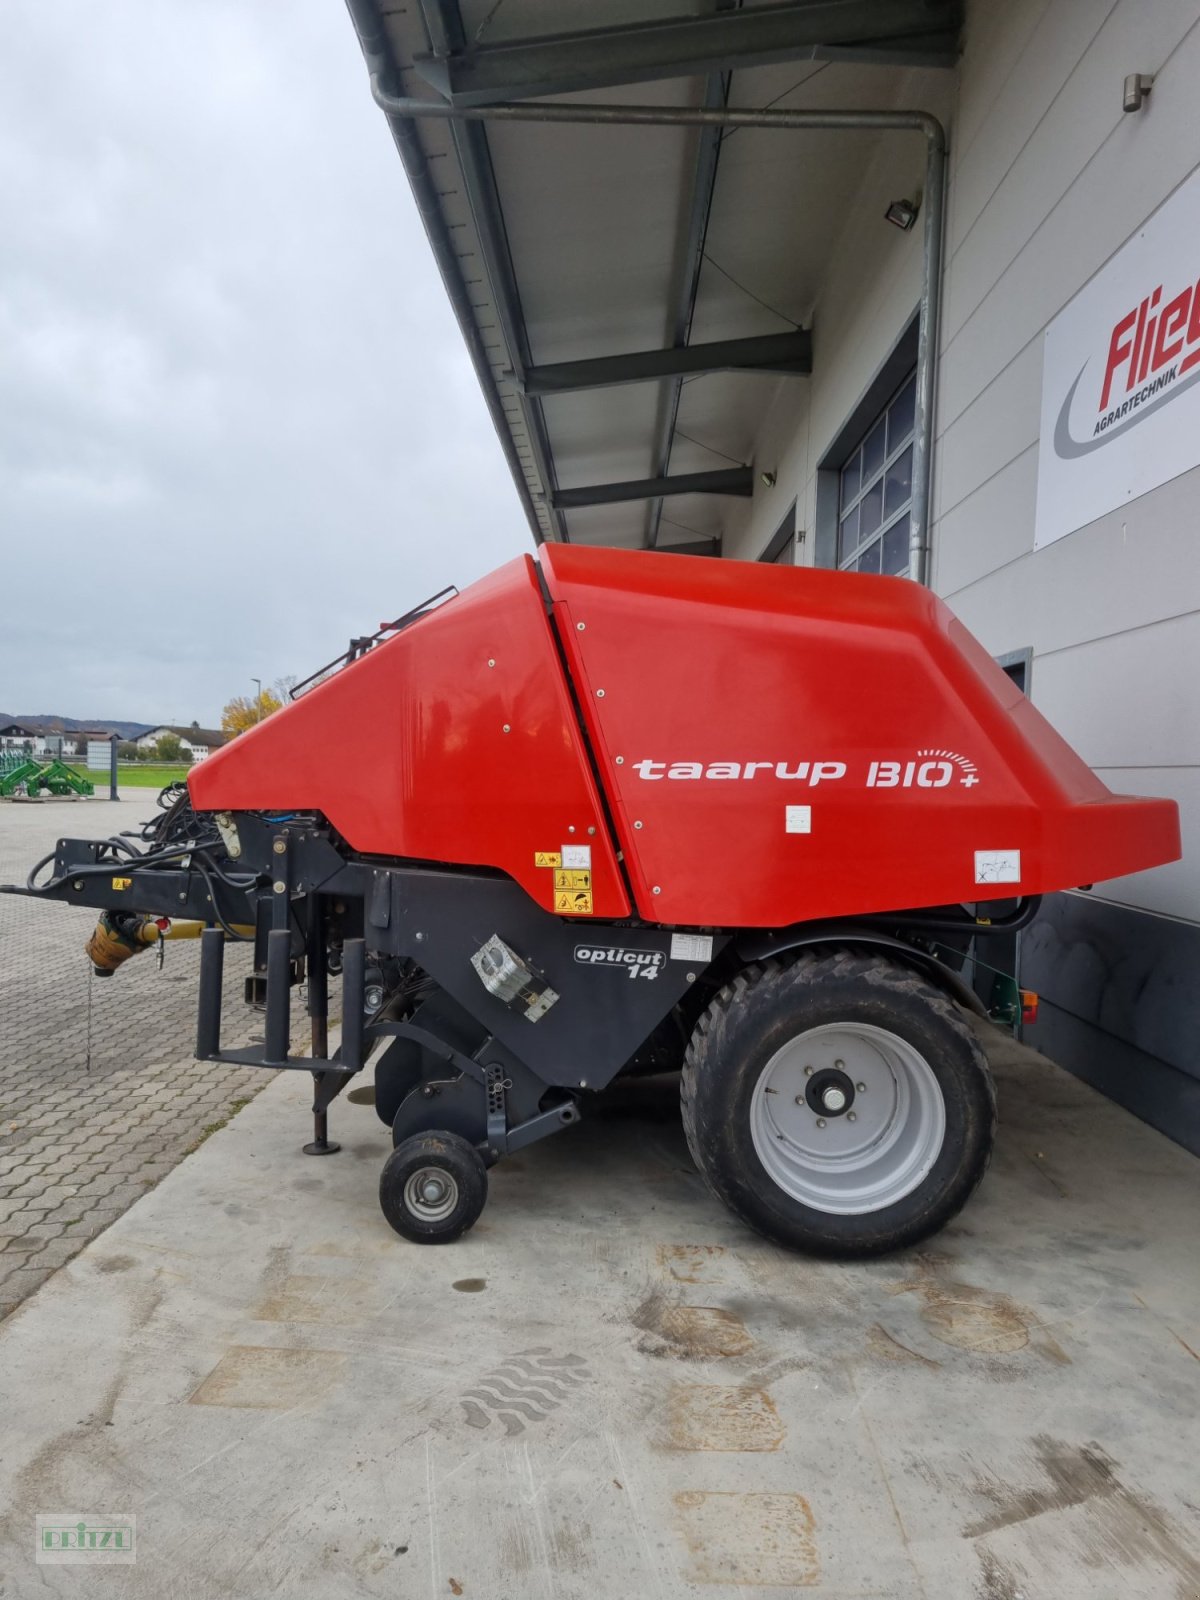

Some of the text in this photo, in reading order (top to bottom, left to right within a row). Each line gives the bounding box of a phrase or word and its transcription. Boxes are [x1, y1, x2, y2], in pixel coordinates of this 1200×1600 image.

[1093, 364, 1178, 437] AGRARTECHNIK
[632, 759, 847, 787] taarup
[576, 949, 663, 966] opticut
[627, 964, 659, 980] 14
